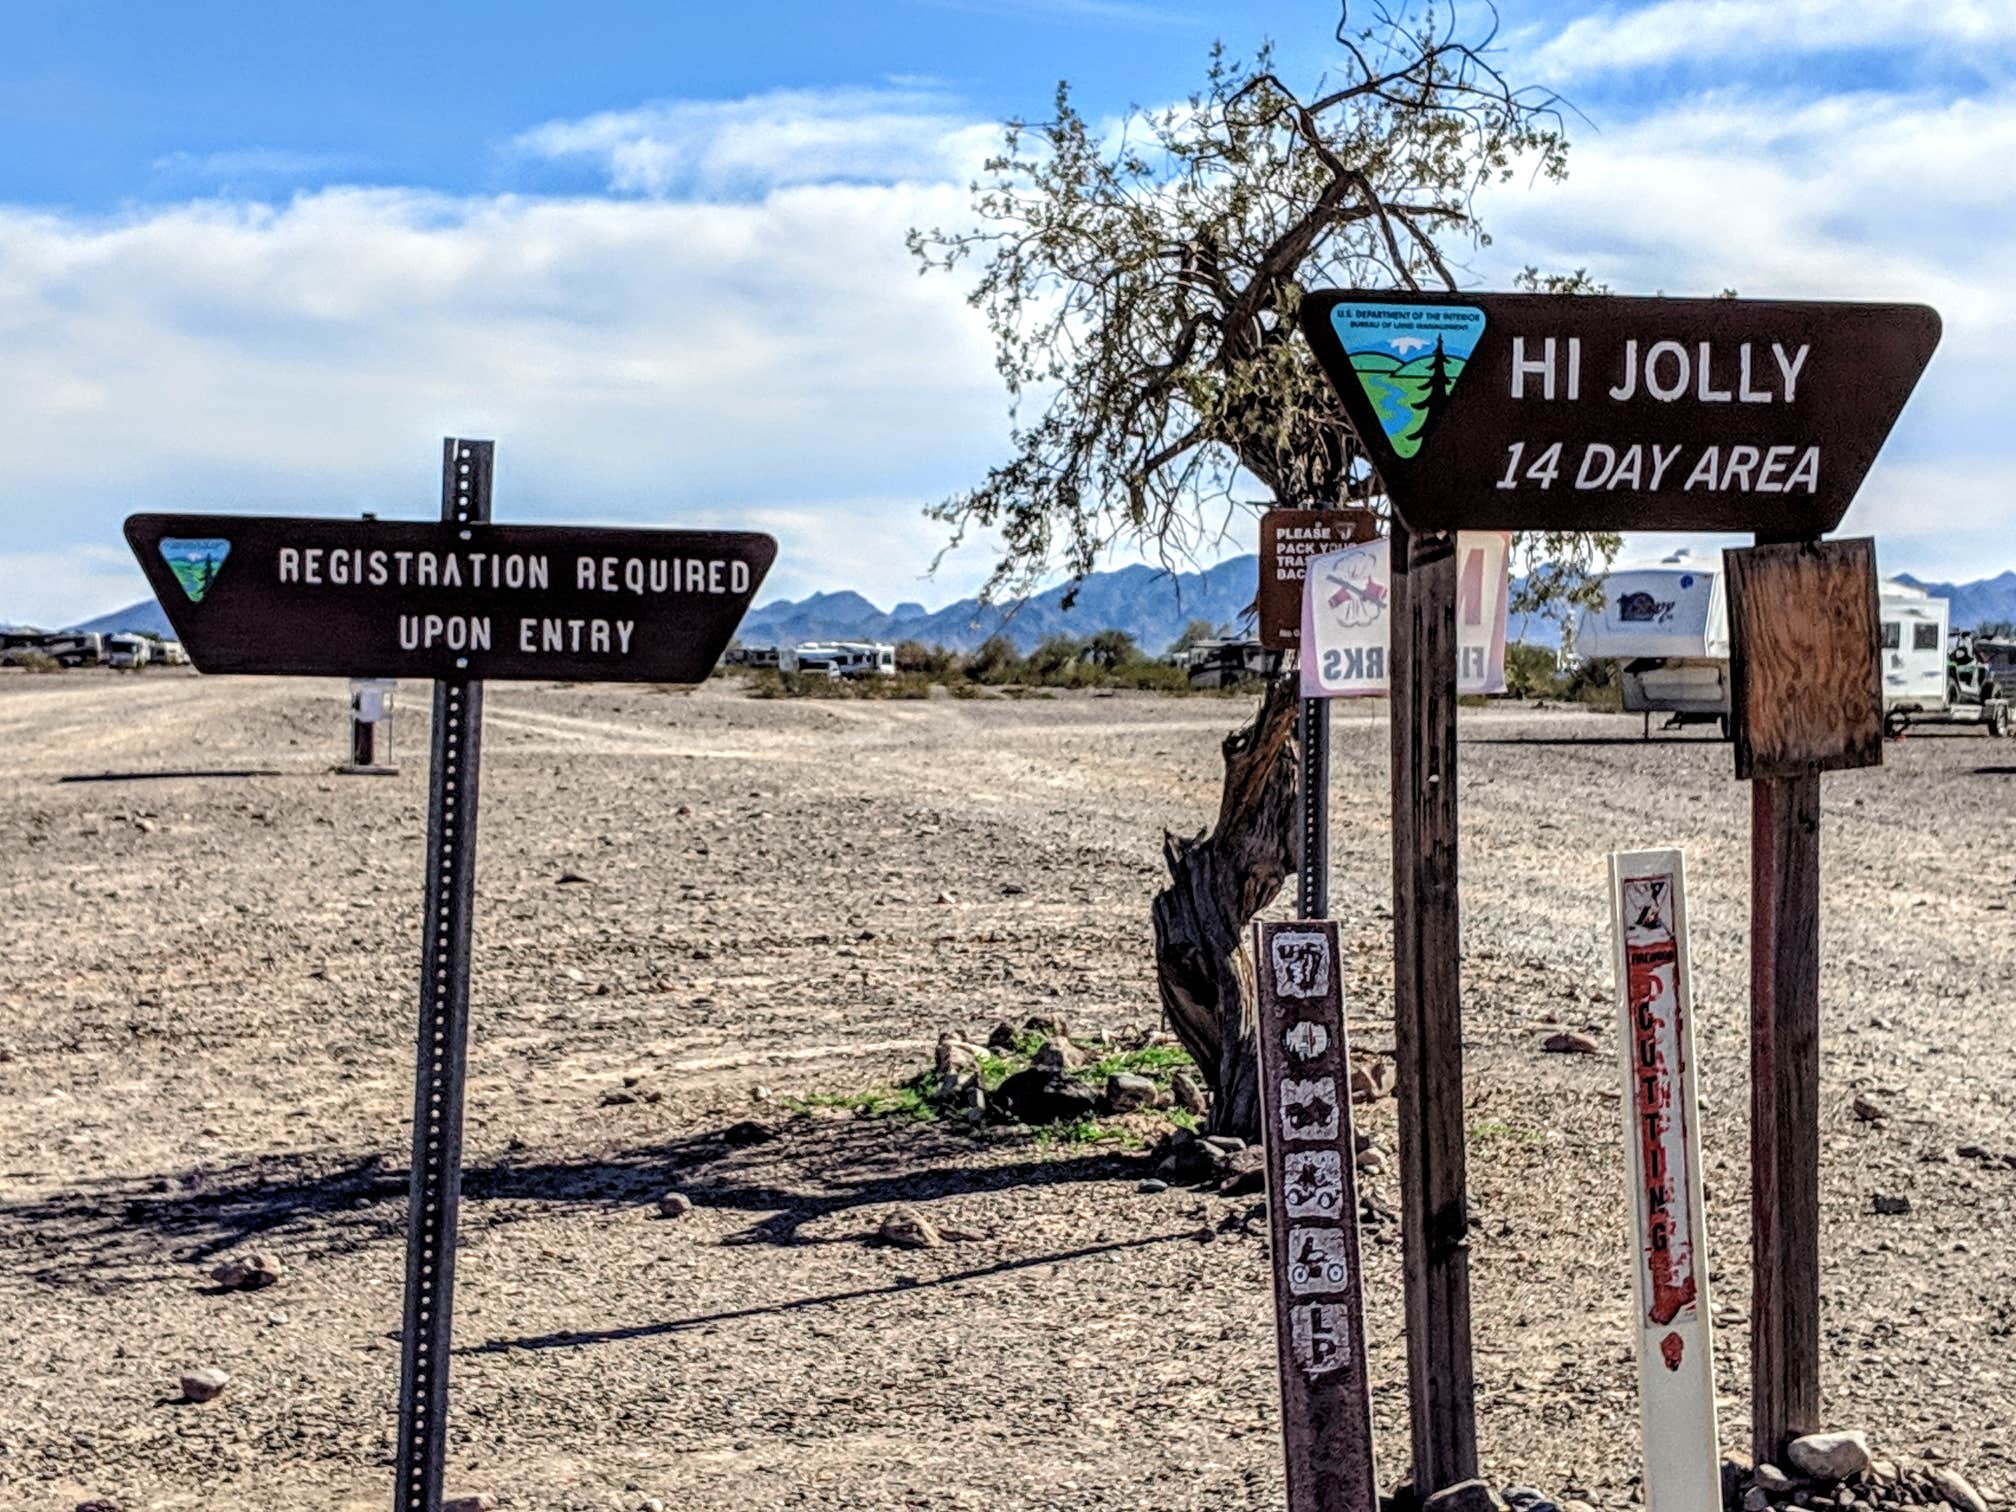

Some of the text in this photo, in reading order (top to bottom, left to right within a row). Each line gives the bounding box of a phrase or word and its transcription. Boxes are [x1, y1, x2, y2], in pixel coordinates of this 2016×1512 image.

[1355, 310, 1410, 321] DEPARTMENT
[1412, 311, 1424, 321] OF
[1426, 312, 1441, 321] THE
[1443, 312, 1480, 322] INTERIOR
[1510, 336, 1810, 403] HI JOLLY
[1496, 441, 1820, 494] 14 DAY AREA
[1276, 527, 1331, 540] PLEASE
[1276, 542, 1315, 555] PACK
[278, 547, 751, 595] REGISTRATION REQUIRED
[1277, 568, 1306, 580] BAC
[399, 614, 635, 654] UPON ENTRY
